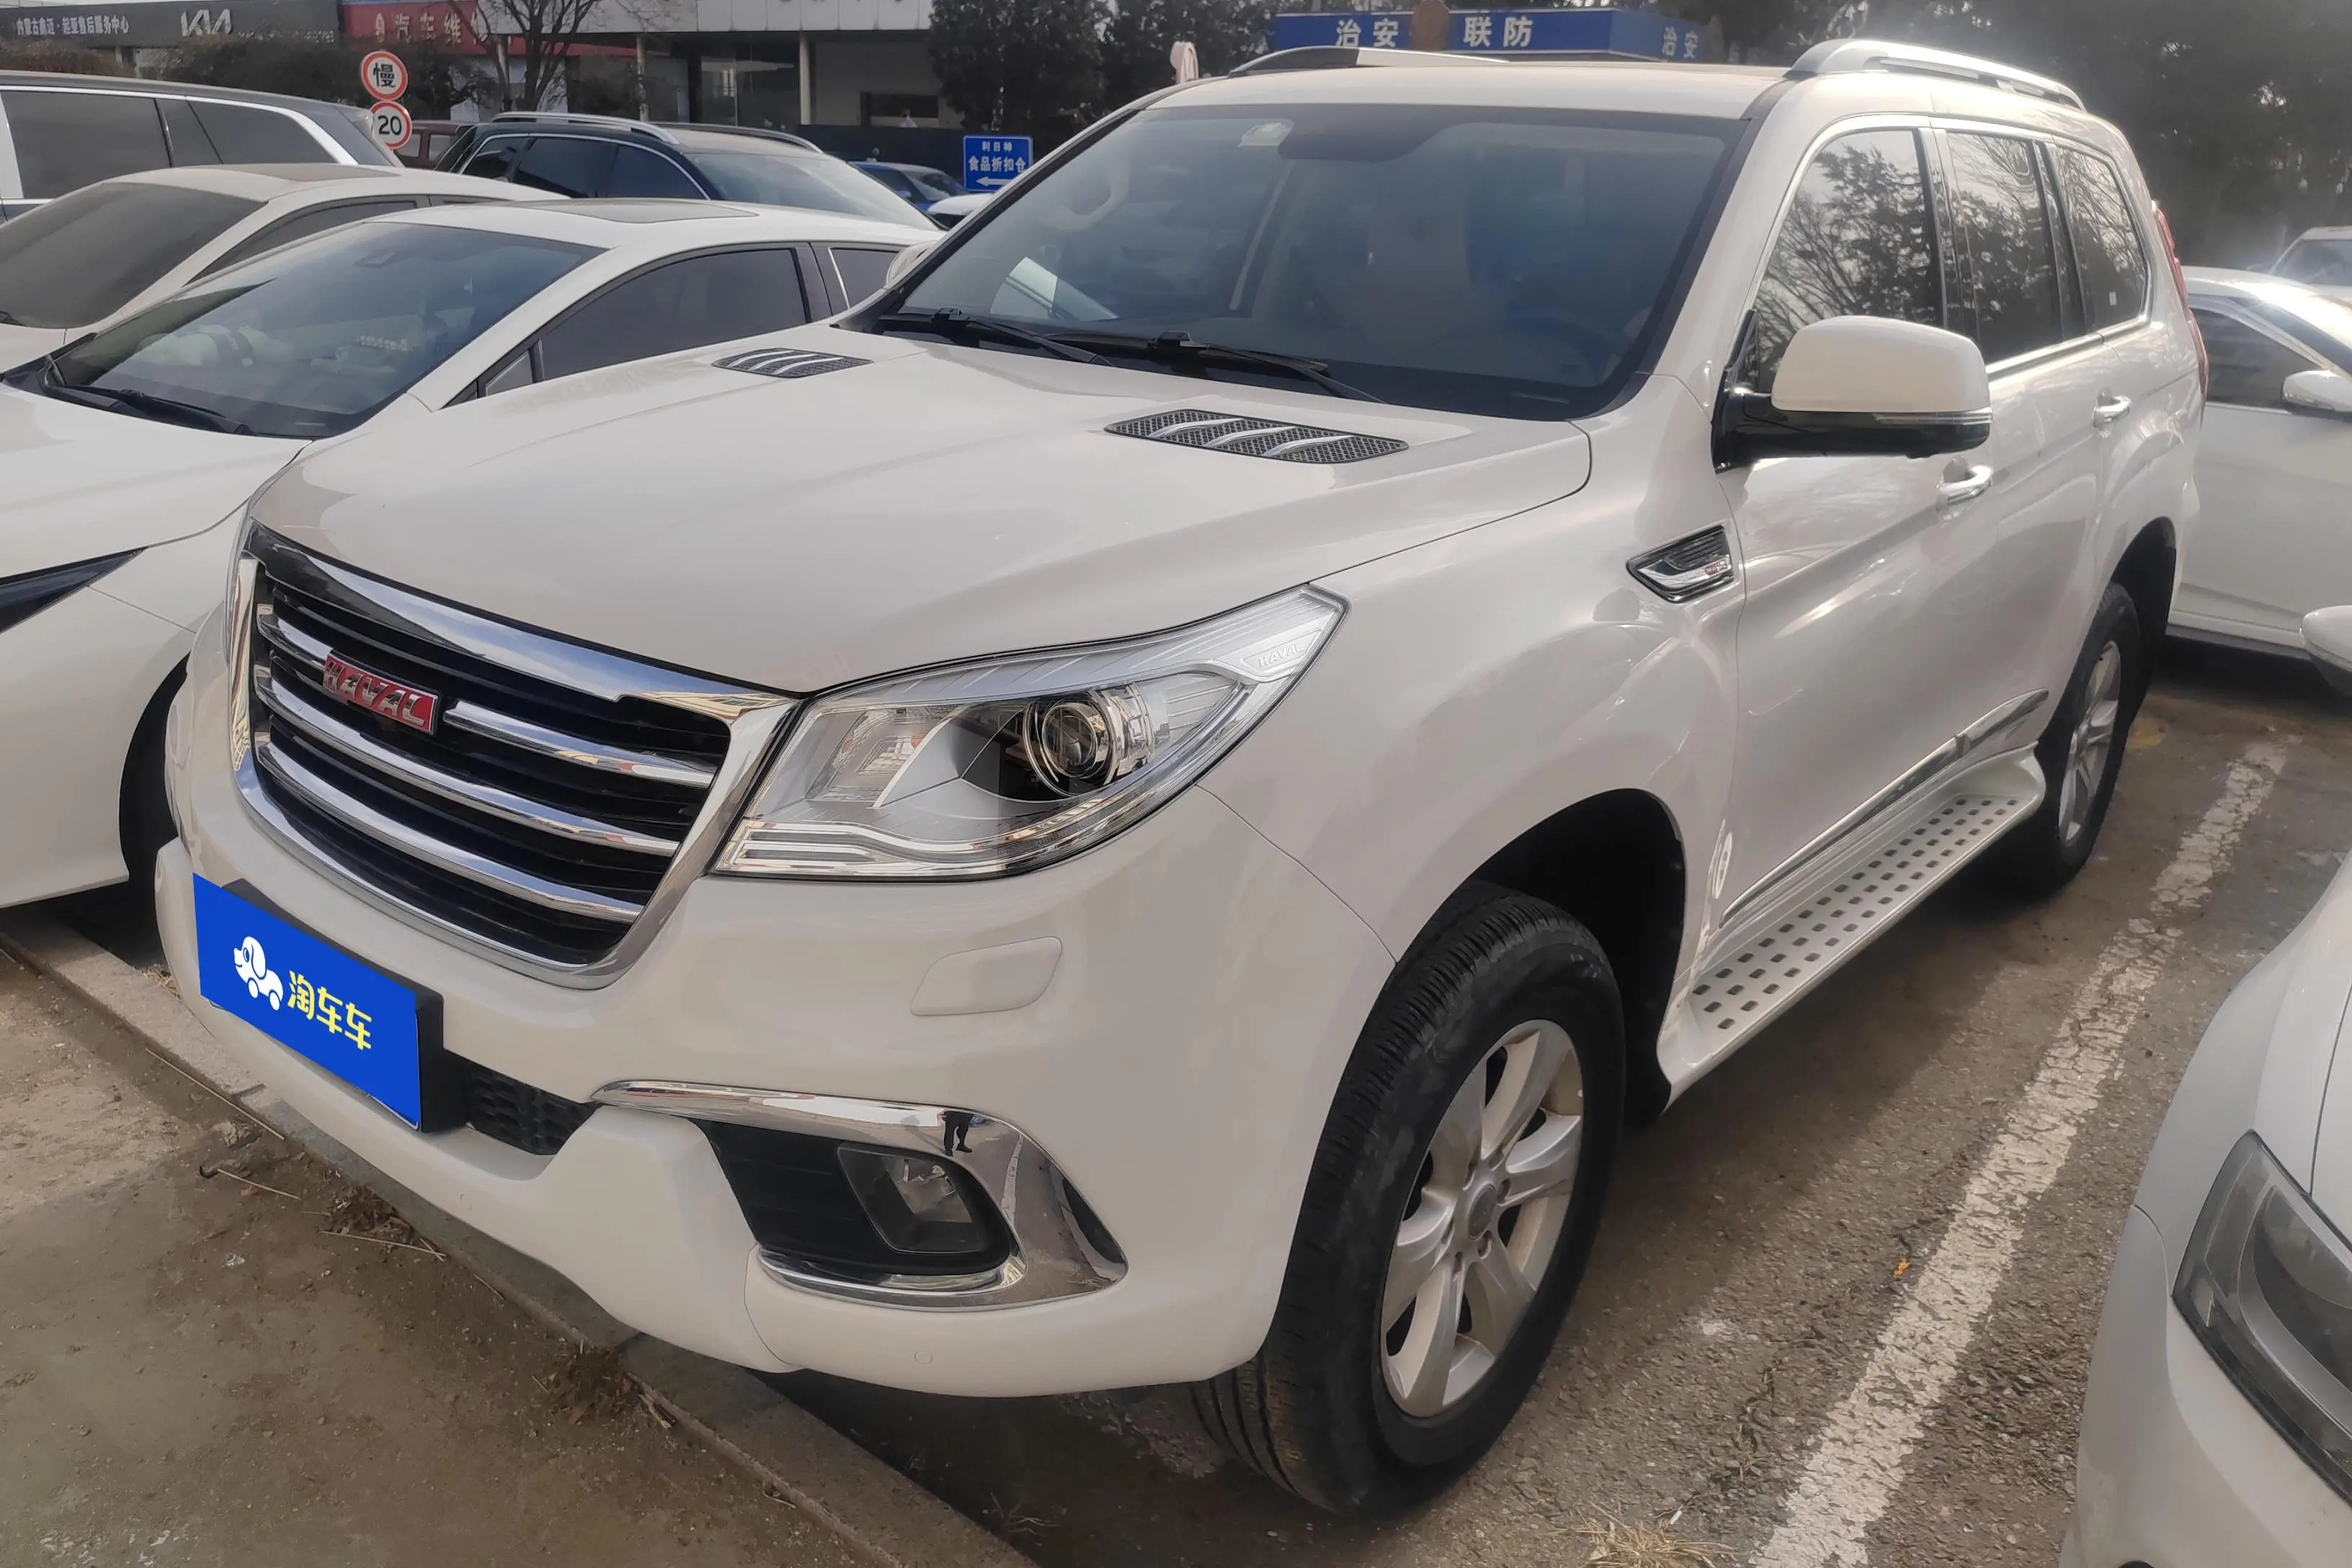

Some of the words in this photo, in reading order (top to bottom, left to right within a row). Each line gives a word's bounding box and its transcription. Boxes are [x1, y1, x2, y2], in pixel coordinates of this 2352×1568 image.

[180, 9, 232, 36] KIA
[1335, 19, 1399, 47] 治安
[1464, 16, 1533, 47] 联防
[1662, 27, 1698, 59] 治安
[373, 62, 396, 88] 慢
[378, 115, 402, 135] 20
[968, 156, 1027, 173] 食品折扣仓
[1258, 643, 1304, 667] HAVAL
[324, 661, 424, 726] HAVAL
